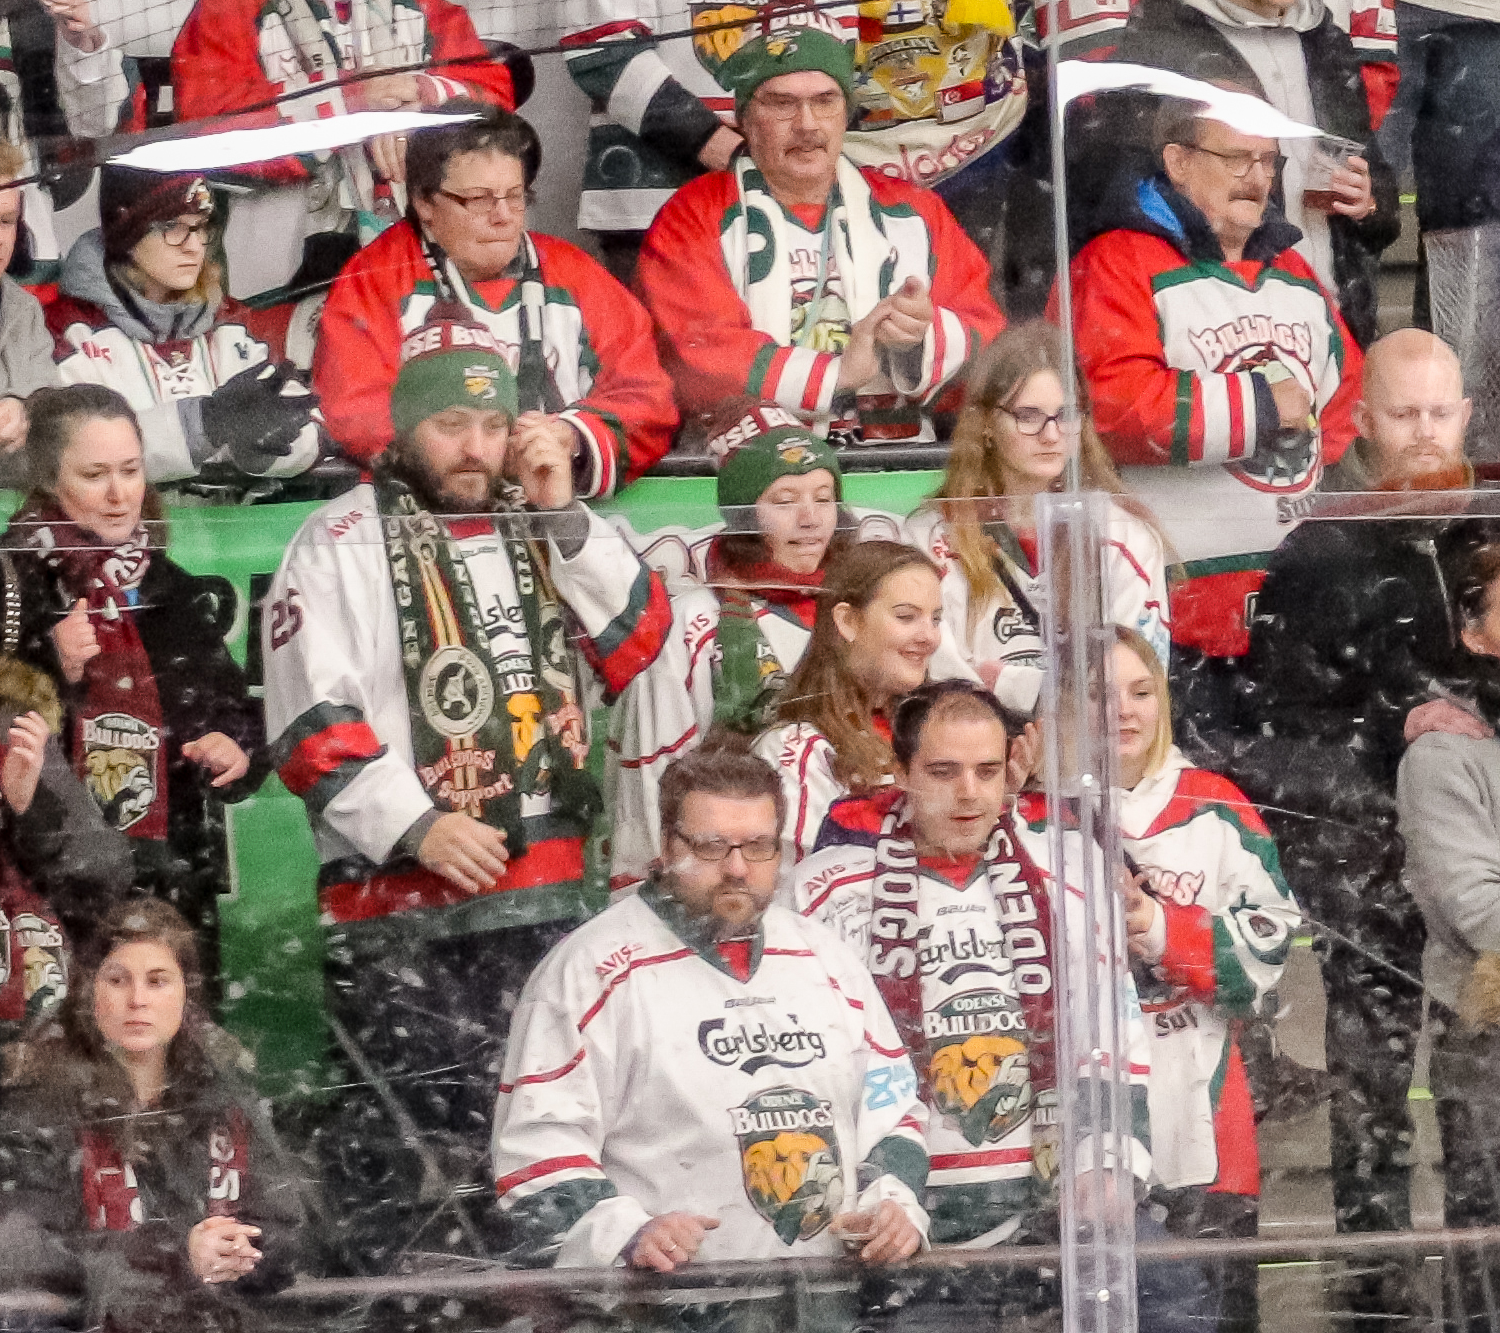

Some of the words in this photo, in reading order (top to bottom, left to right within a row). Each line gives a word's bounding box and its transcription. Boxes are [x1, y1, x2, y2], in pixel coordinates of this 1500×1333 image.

[804, 865, 847, 897] AVIS
[697, 1013, 827, 1067] Carlsberg
[922, 1011, 1028, 1040] BULLDOG
[729, 1100, 835, 1136] BULLDOGS
